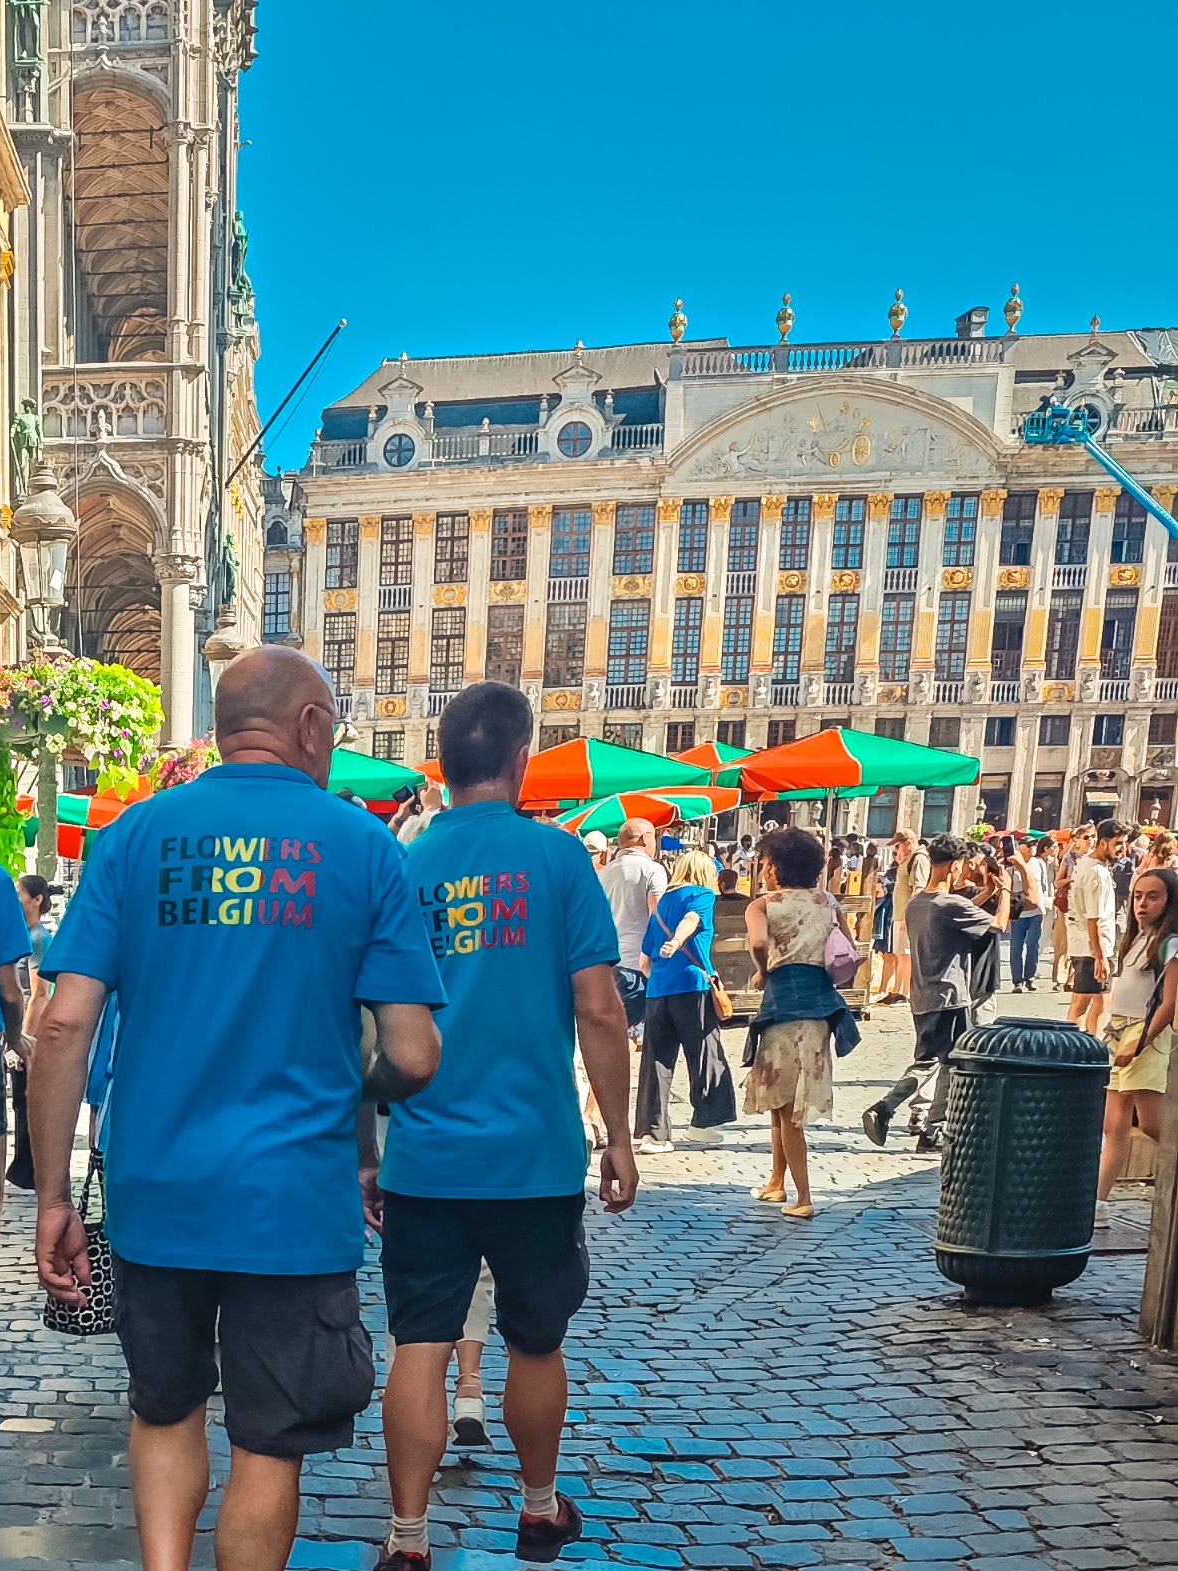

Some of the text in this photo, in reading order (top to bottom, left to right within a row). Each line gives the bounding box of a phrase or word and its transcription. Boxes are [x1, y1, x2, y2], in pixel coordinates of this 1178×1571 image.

[159, 835, 322, 864] FLOWERS
[158, 866, 316, 897] FROM
[418, 871, 530, 907] LOWERS
[157, 898, 313, 929] BELGIUM
[430, 925, 526, 959] ELGIUM
